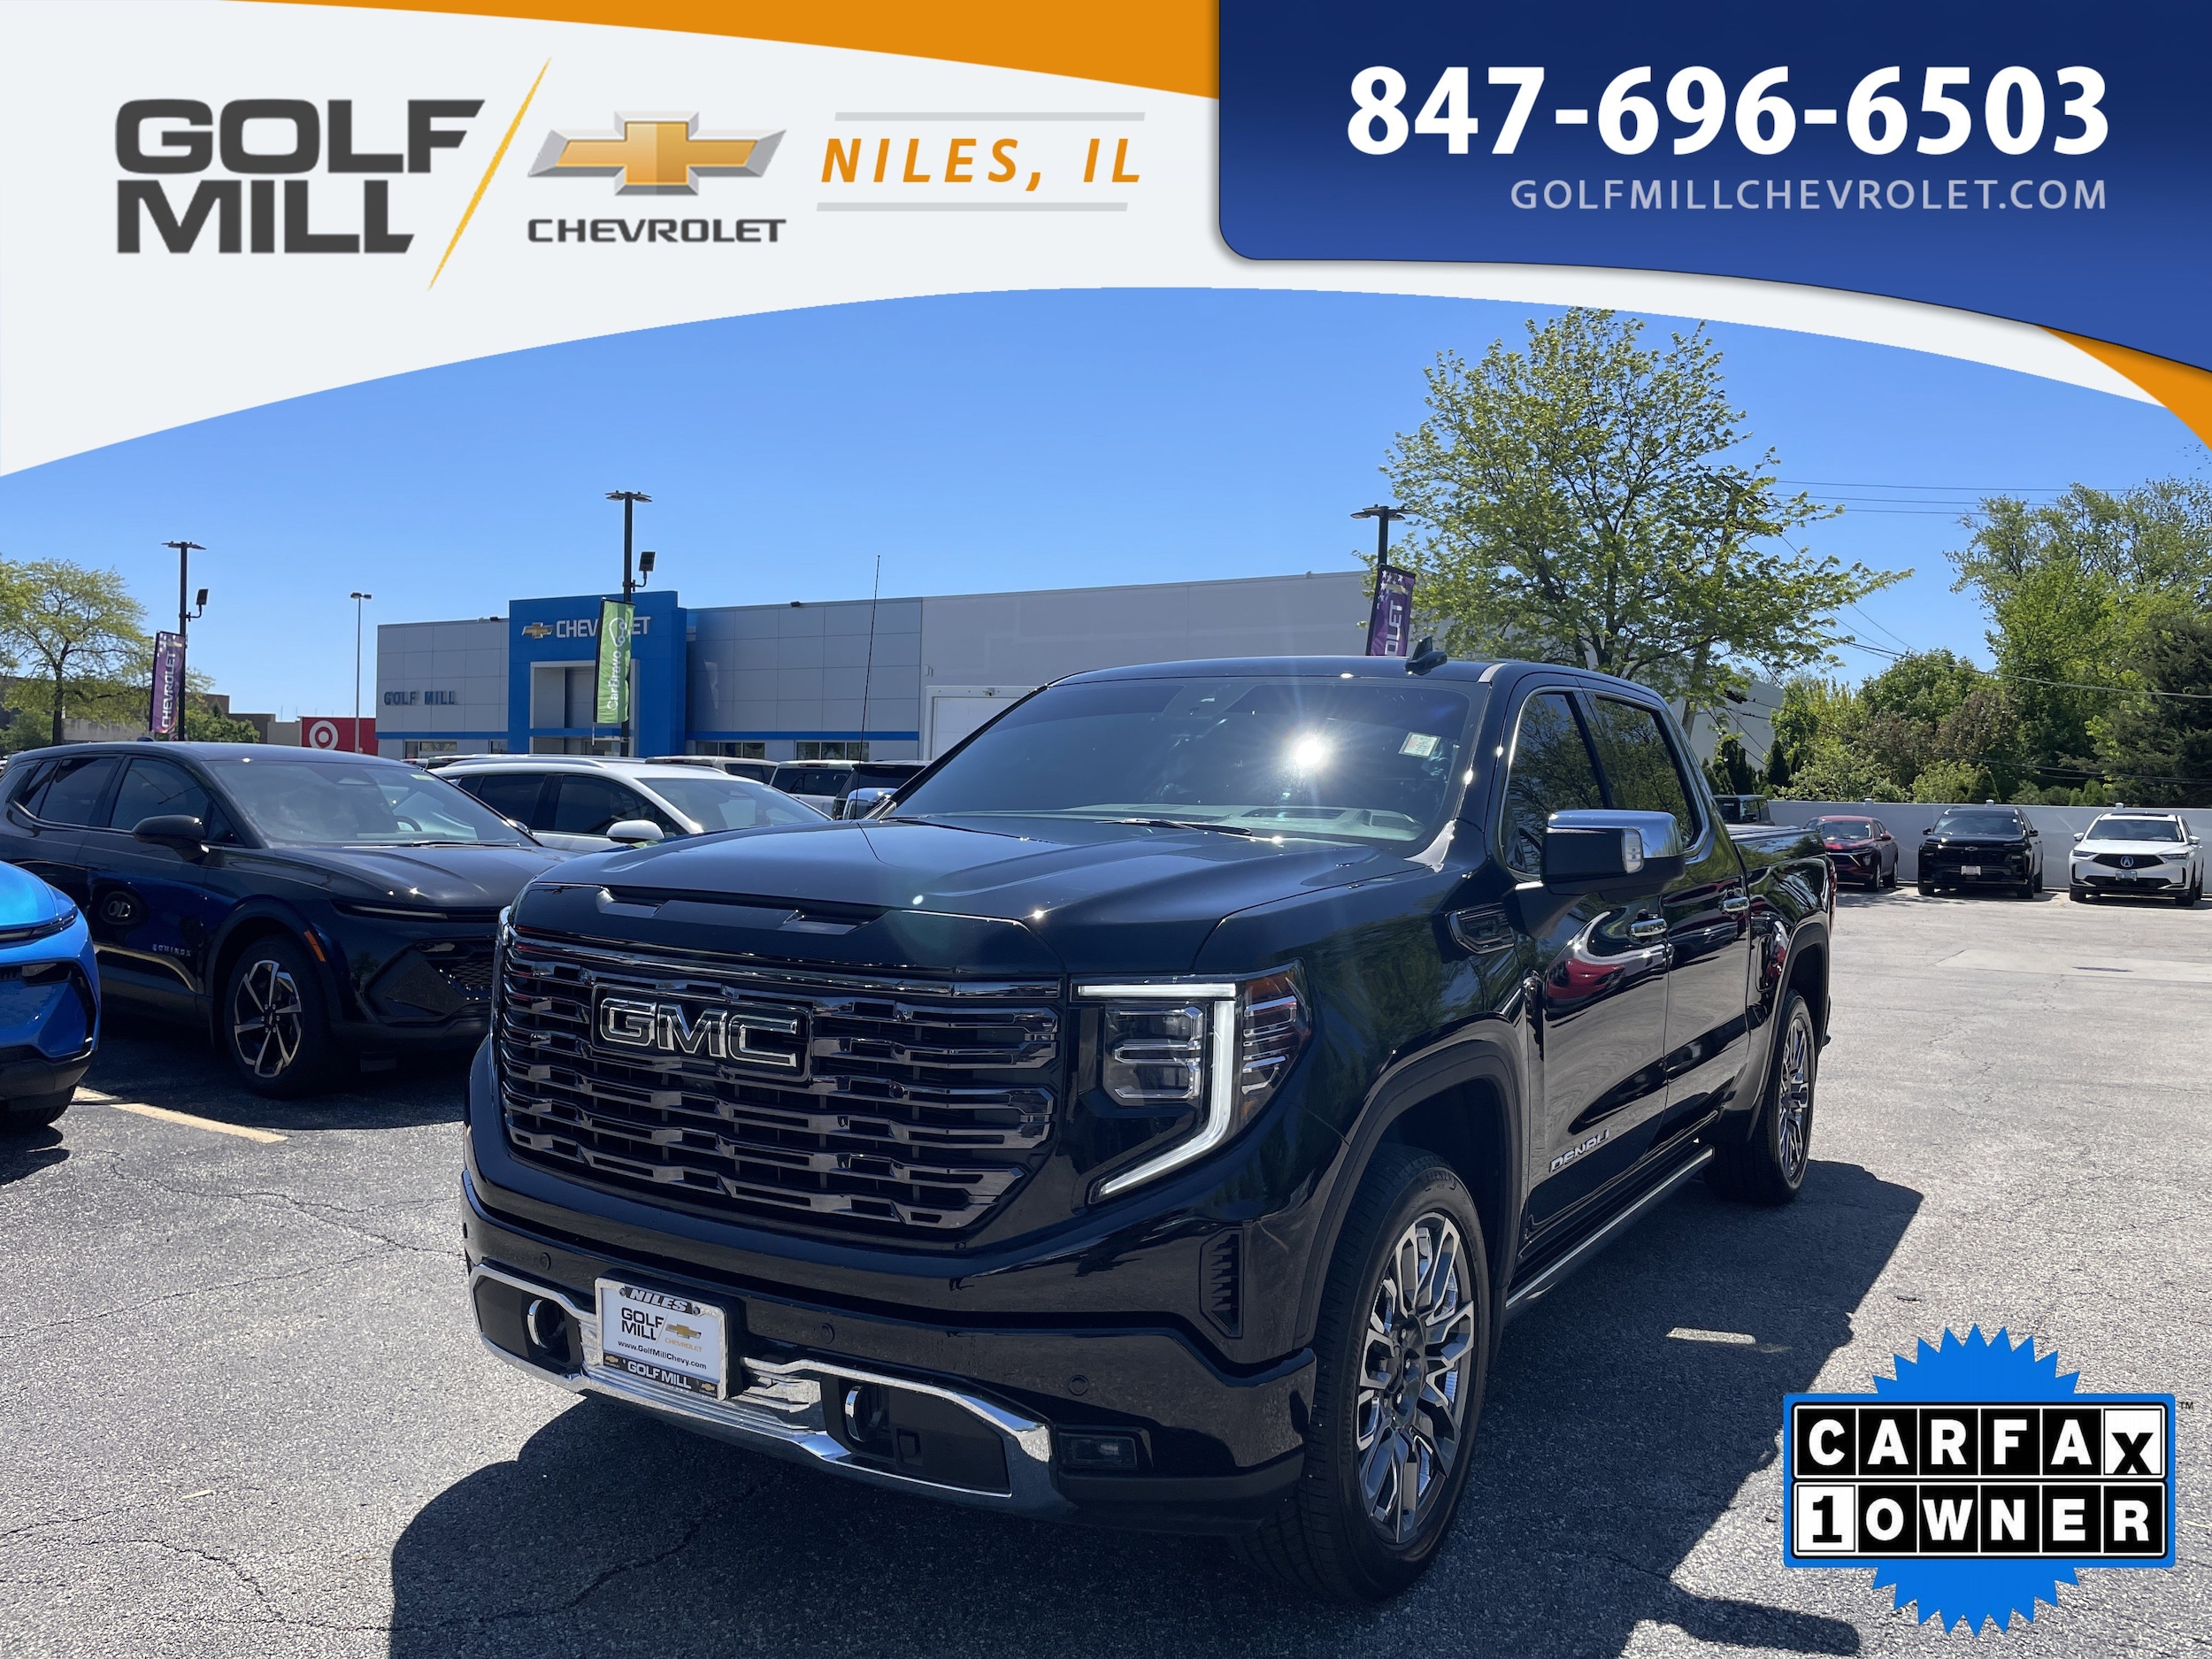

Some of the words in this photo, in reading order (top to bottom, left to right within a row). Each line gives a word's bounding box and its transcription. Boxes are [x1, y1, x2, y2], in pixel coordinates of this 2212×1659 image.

[556, 616, 651, 639] CHEVET
[161, 650, 176, 728] CHEVROLET
[384, 691, 418, 705] GOLF
[425, 690, 457, 705] MILL
[600, 997, 798, 1068] GMC
[1548, 1128, 1609, 1173] DENALI
[630, 1289, 688, 1311] NILES
[621, 1307, 664, 1328] GOLF
[621, 1320, 657, 1341] MILL
[618, 1340, 707, 1370] www.GolfMillChevy.com
[627, 1360, 661, 1379] GOLF
[661, 1370, 692, 1389] MILL
